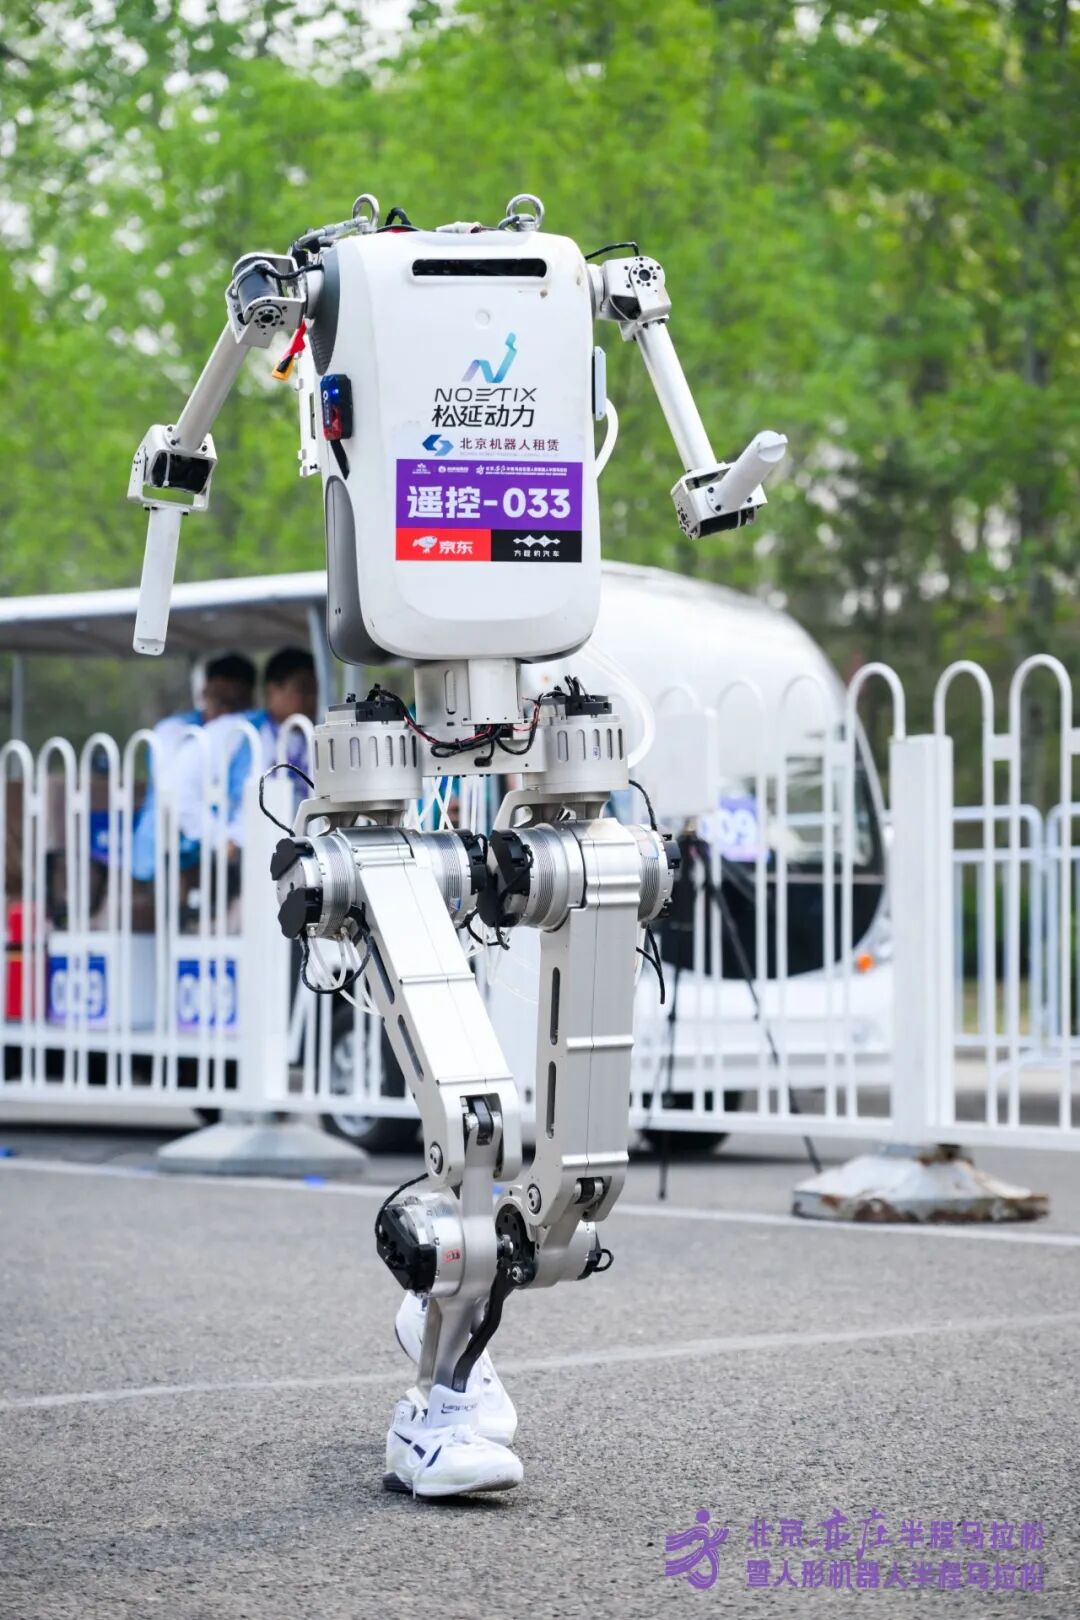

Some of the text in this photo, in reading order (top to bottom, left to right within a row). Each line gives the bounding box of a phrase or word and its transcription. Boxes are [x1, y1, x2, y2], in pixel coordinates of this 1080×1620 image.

[434, 387, 537, 402] NOETIX
[431, 404, 535, 428] 松延动力
[459, 437, 560, 452] 北京机器人租赁
[407, 485, 571, 519] 遥控-033
[439, 540, 474, 555] 京东
